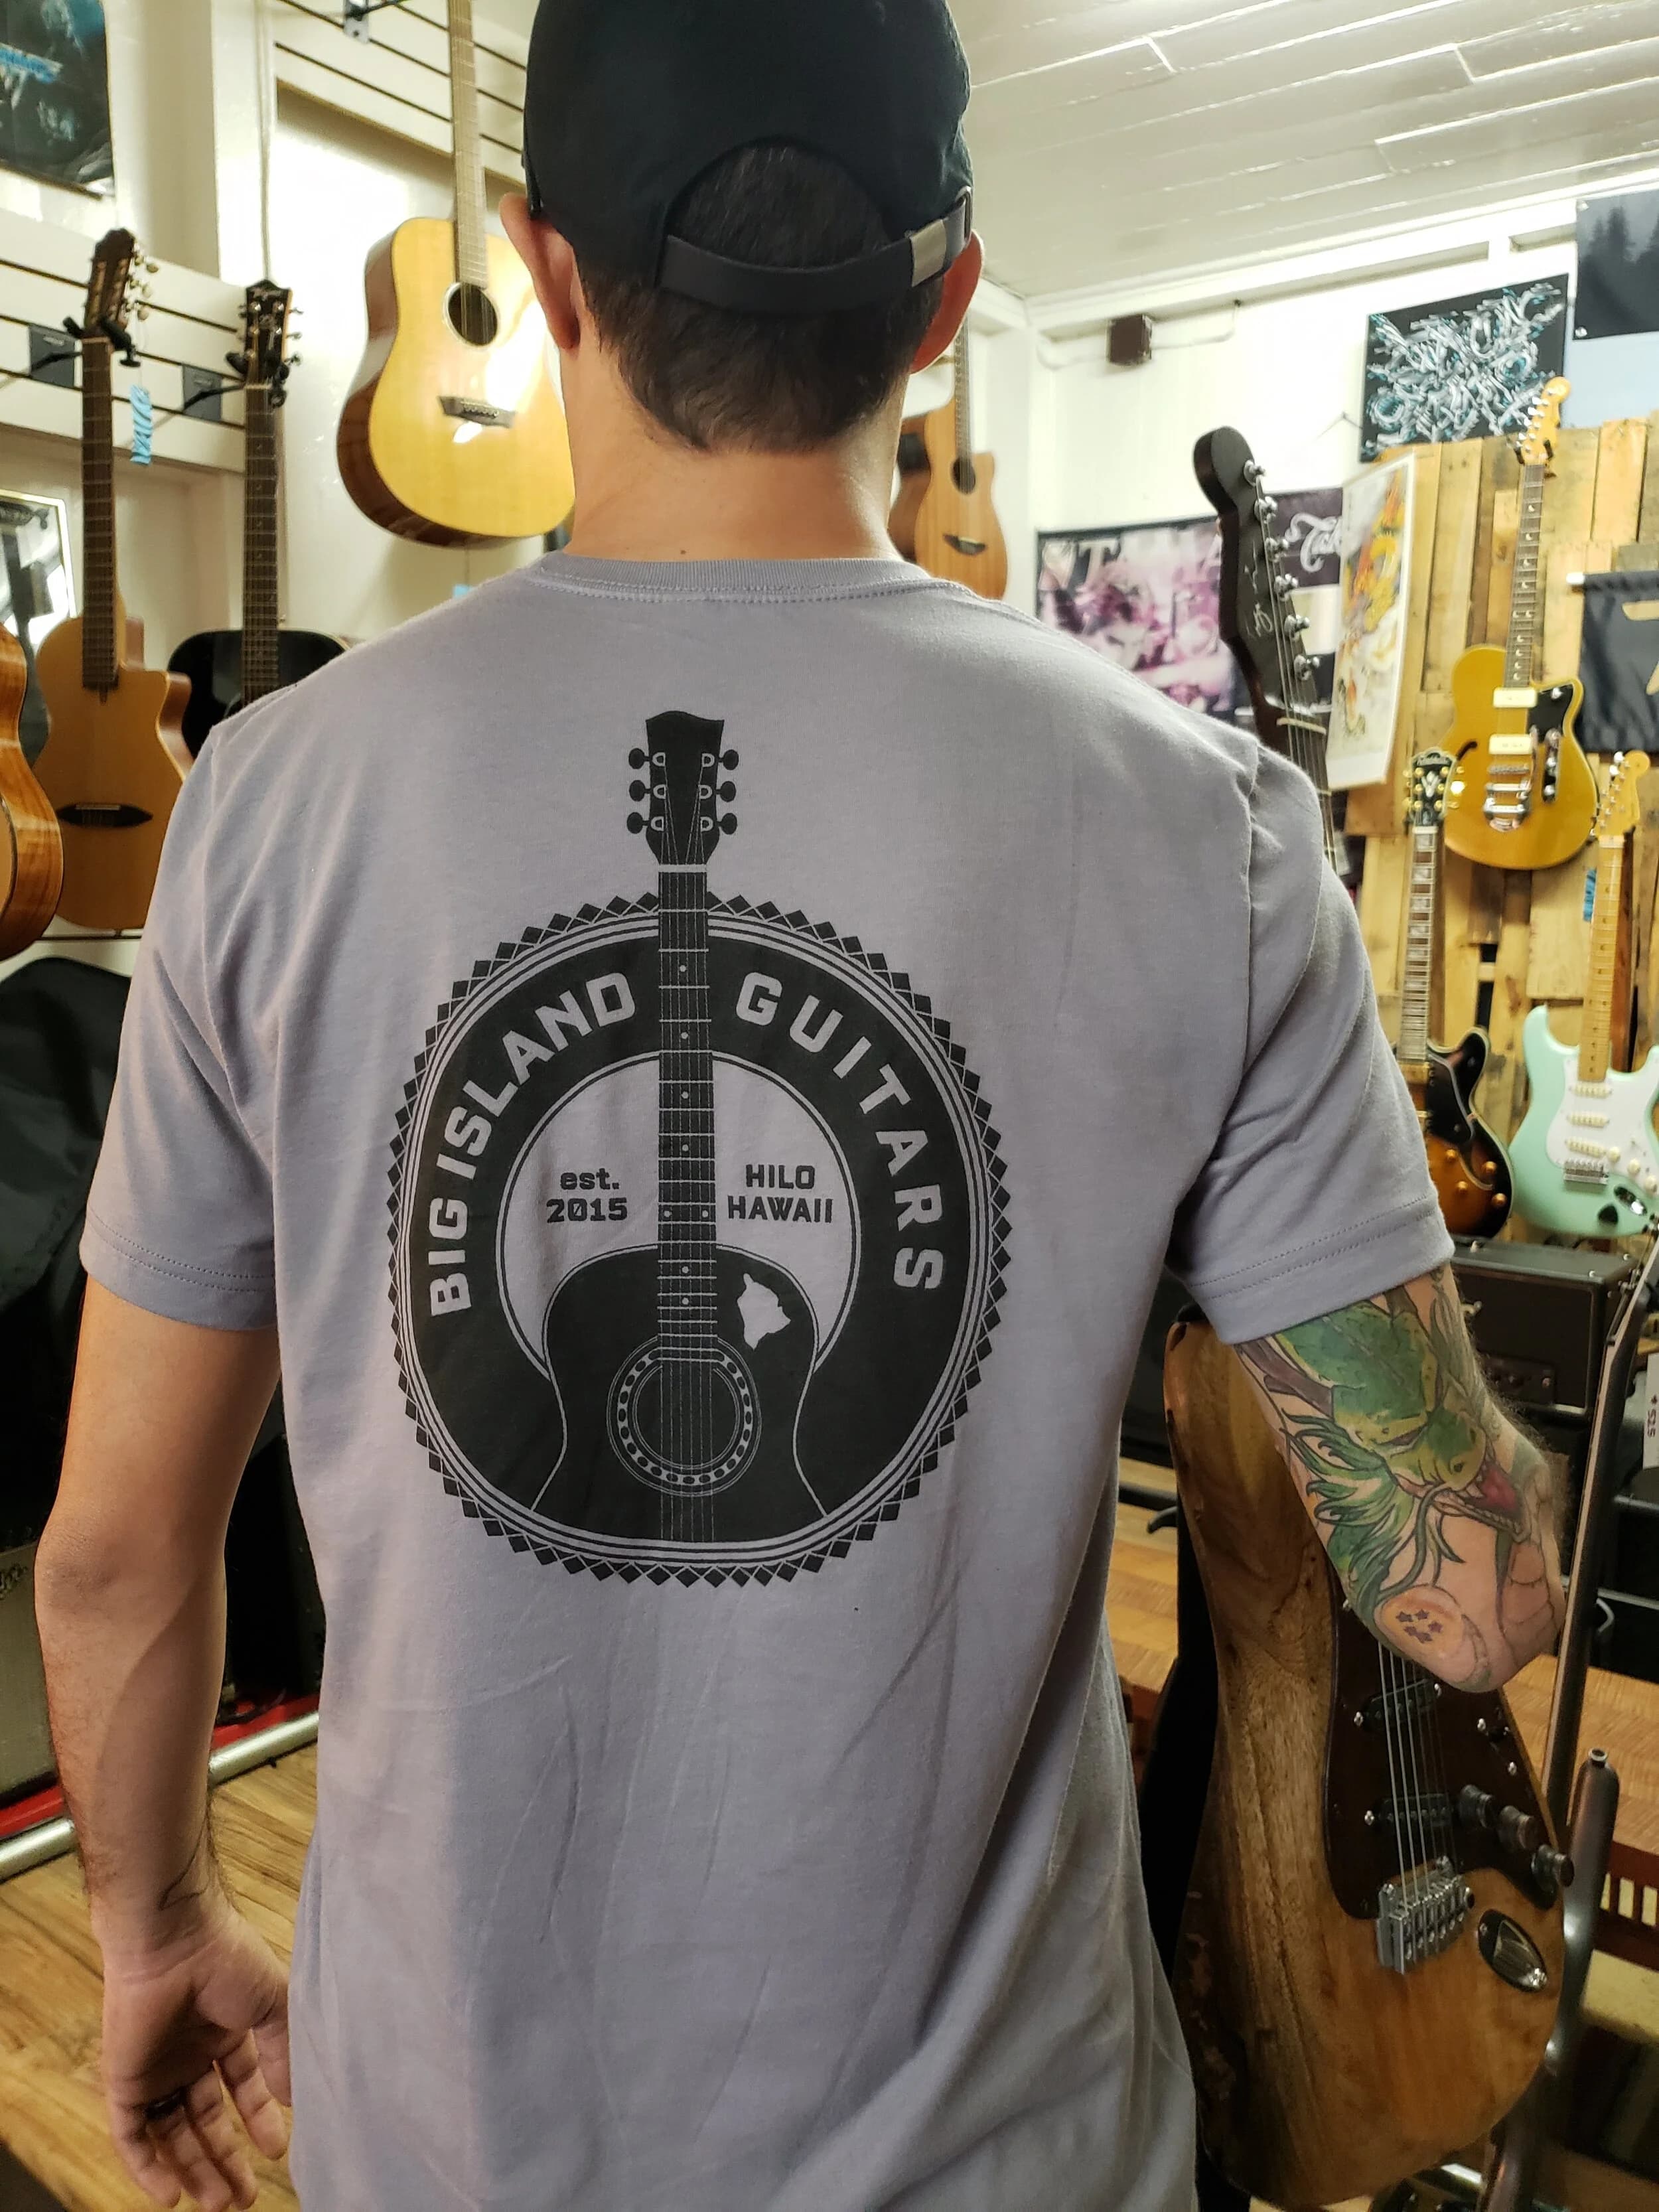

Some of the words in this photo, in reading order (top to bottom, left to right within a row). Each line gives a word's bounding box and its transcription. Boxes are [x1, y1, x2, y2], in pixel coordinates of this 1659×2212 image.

[437, 972, 636, 1180] ISLAND
[735, 972, 944, 1290] GUITARS
[559, 1166, 620, 1190] est.
[746, 1164, 816, 1190] HILO
[546, 1198, 628, 1223] 2015
[727, 1196, 833, 1223] HAWAII
[428, 1197, 471, 1317] BIG
